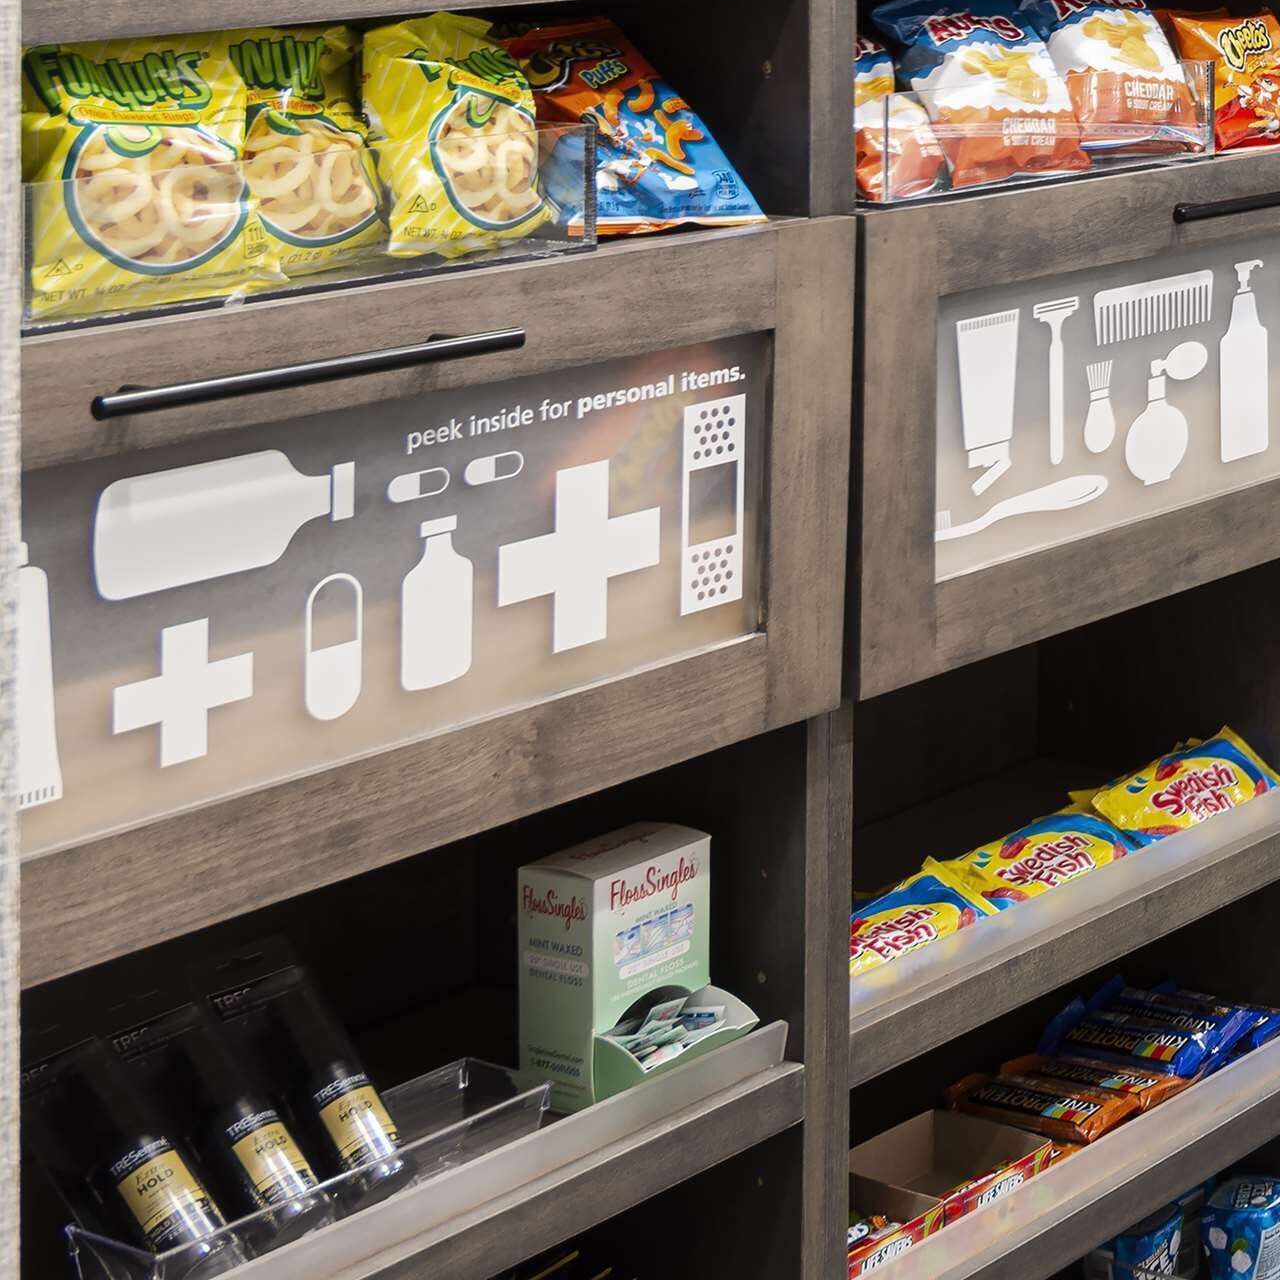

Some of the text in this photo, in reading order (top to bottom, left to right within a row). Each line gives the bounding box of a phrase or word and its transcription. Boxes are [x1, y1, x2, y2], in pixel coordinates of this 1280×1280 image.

[1124, 81, 1174, 102] CHEDDAR
[407, 364, 746, 455] peek inside for personal items.
[1152, 764, 1239, 815] Swedish
[1191, 788, 1231, 818] Fish
[994, 834, 1090, 886] Swedish
[1038, 851, 1097, 890] Fish
[338, 1100, 373, 1122] HOLD
[254, 1136, 287, 1157] HOLD
[136, 1167, 174, 1196] HOLD
